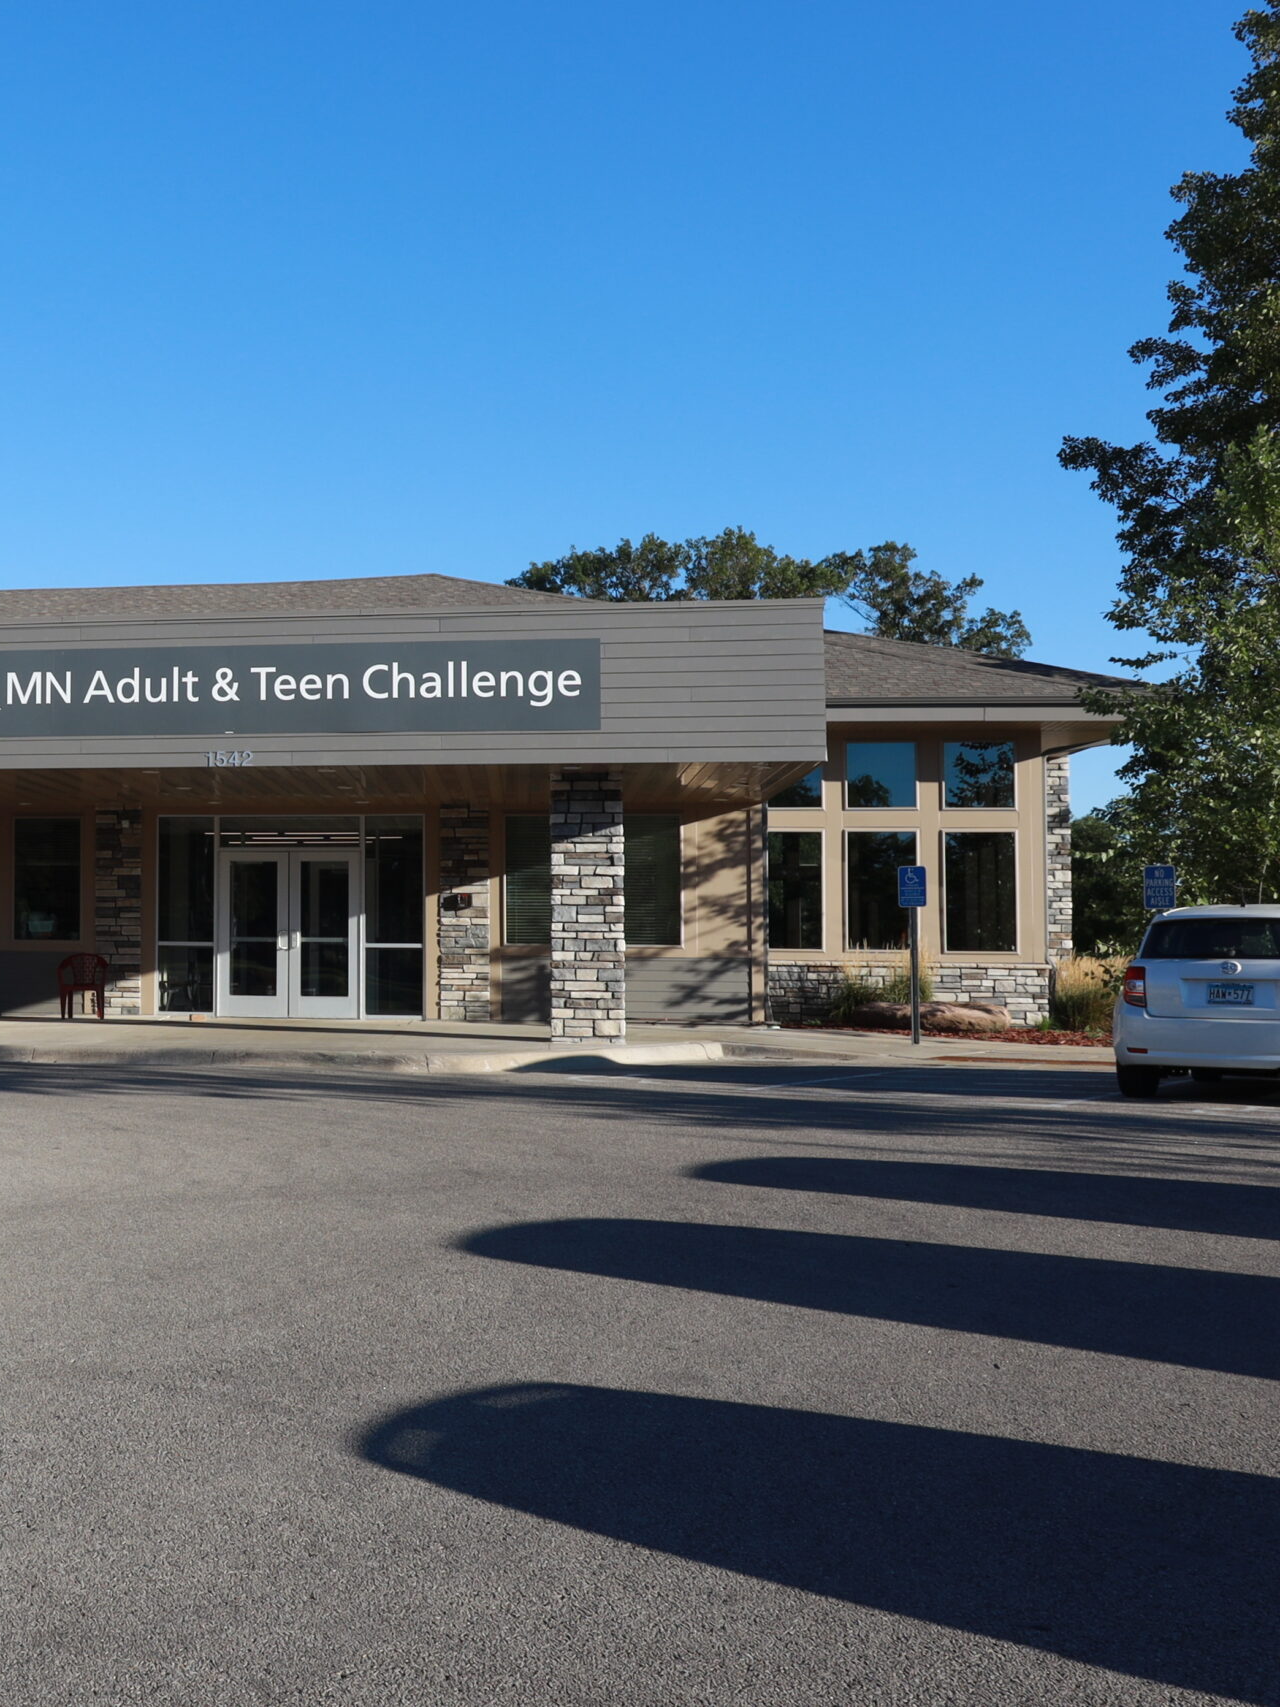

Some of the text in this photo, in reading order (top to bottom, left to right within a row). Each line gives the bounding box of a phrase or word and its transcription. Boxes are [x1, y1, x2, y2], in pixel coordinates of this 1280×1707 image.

[6, 660, 582, 707] MN Adult & Teen Challenge
[204, 751, 254, 767] 1542
[1154, 870, 1165, 878] NO
[1146, 878, 1174, 887] PARKING
[1147, 888, 1174, 896] ACCESS
[1151, 896, 1170, 905] AISLE
